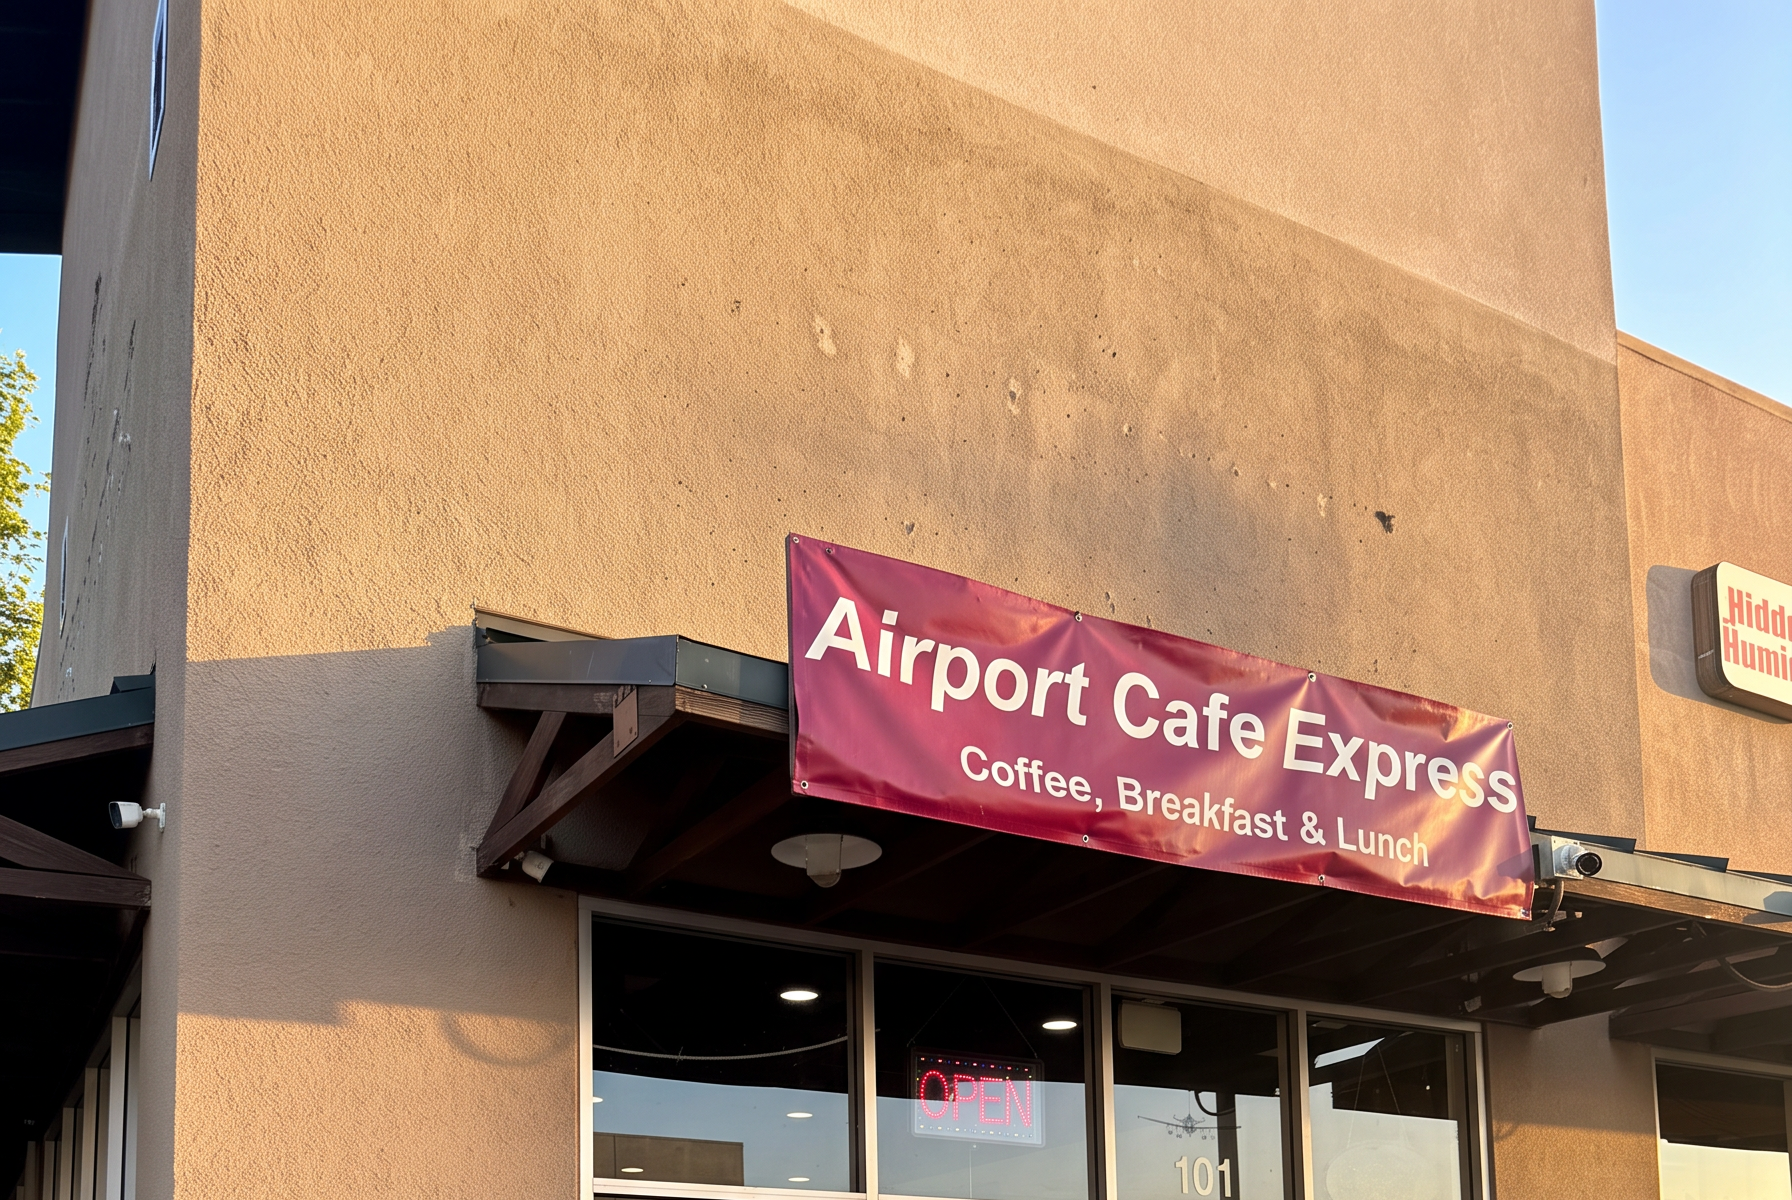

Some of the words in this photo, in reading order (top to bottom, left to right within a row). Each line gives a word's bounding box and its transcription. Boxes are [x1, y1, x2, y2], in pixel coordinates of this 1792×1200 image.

[1723, 625, 1792, 682] Humi
[805, 597, 1090, 727] Airport
[1112, 672, 1266, 760] Cafe
[1282, 709, 1518, 814] Express
[959, 745, 1105, 813] Coffee,
[1117, 776, 1287, 843] Breakfast
[1299, 810, 1327, 846] &
[1336, 815, 1430, 868] Lunch
[919, 1069, 1032, 1128] OPEN
[1174, 1155, 1232, 1198] 101
